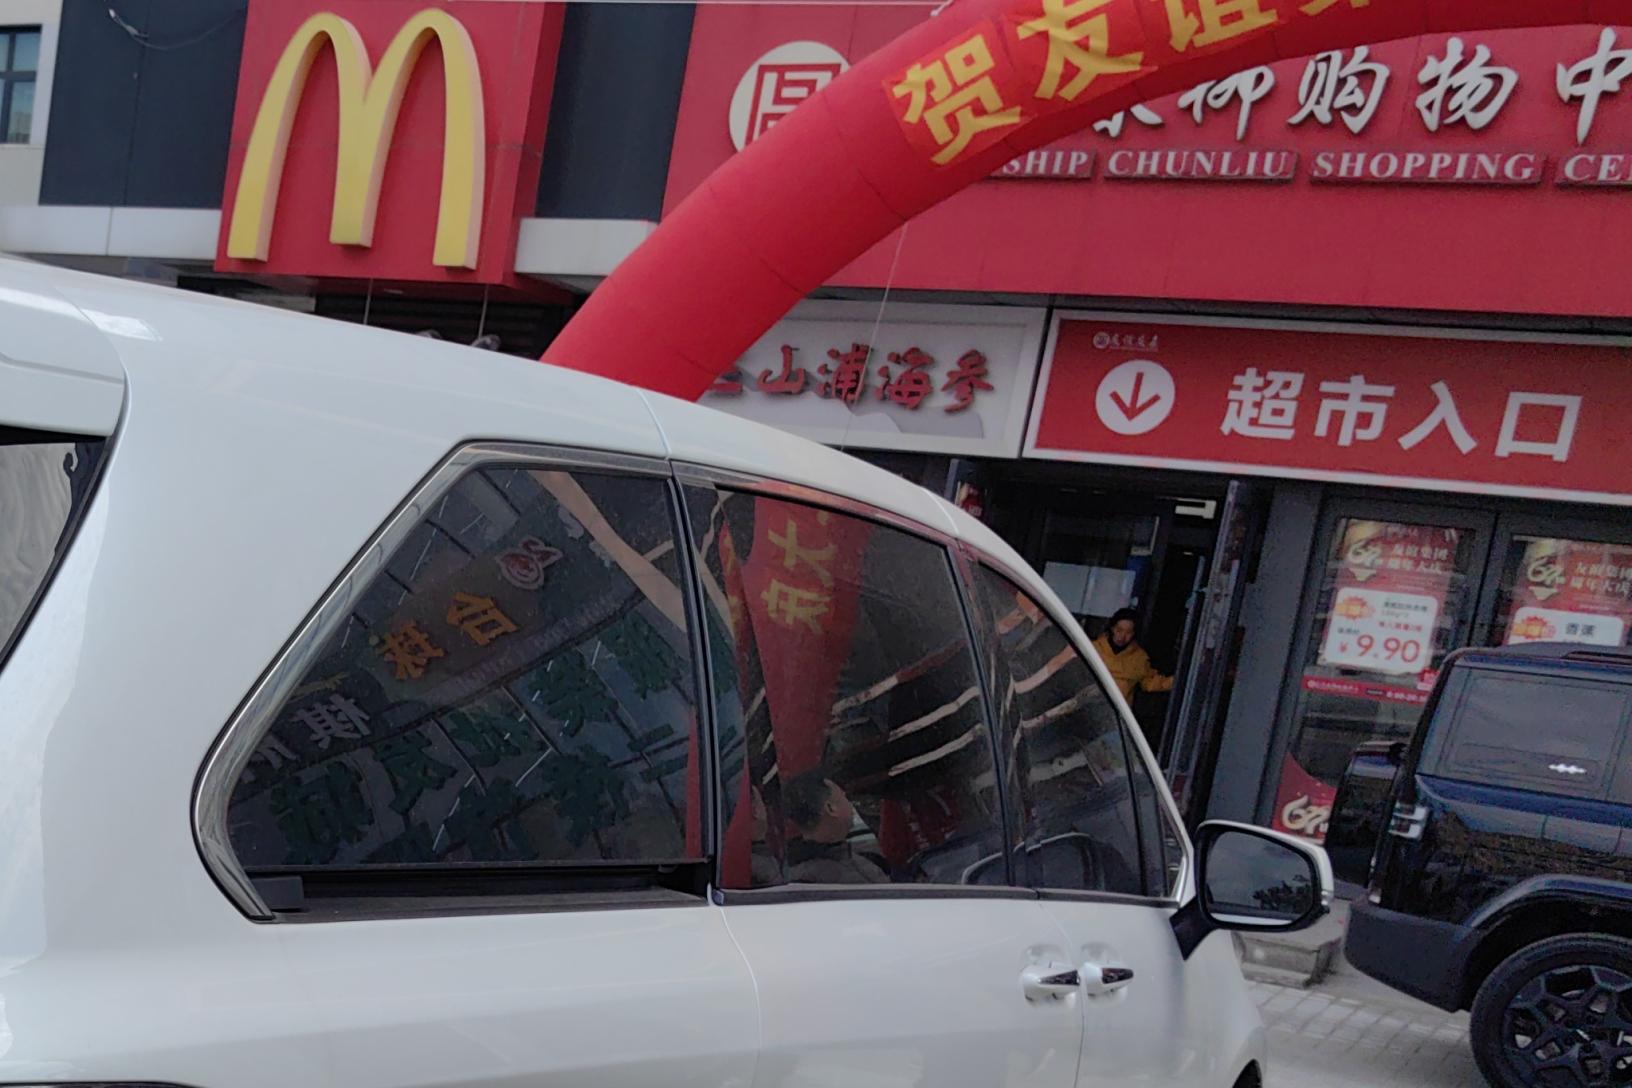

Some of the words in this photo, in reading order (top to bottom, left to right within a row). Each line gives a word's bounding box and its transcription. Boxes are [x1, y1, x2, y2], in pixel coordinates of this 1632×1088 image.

[892, 0, 1369, 165] 贺友
[1093, 27, 1632, 146] 柳购物中
[1108, 151, 1288, 177] CHUNLIU
[1313, 152, 1535, 180] SHOPPING
[1564, 154, 1632, 181] CE
[1220, 367, 1583, 463] 超市入口
